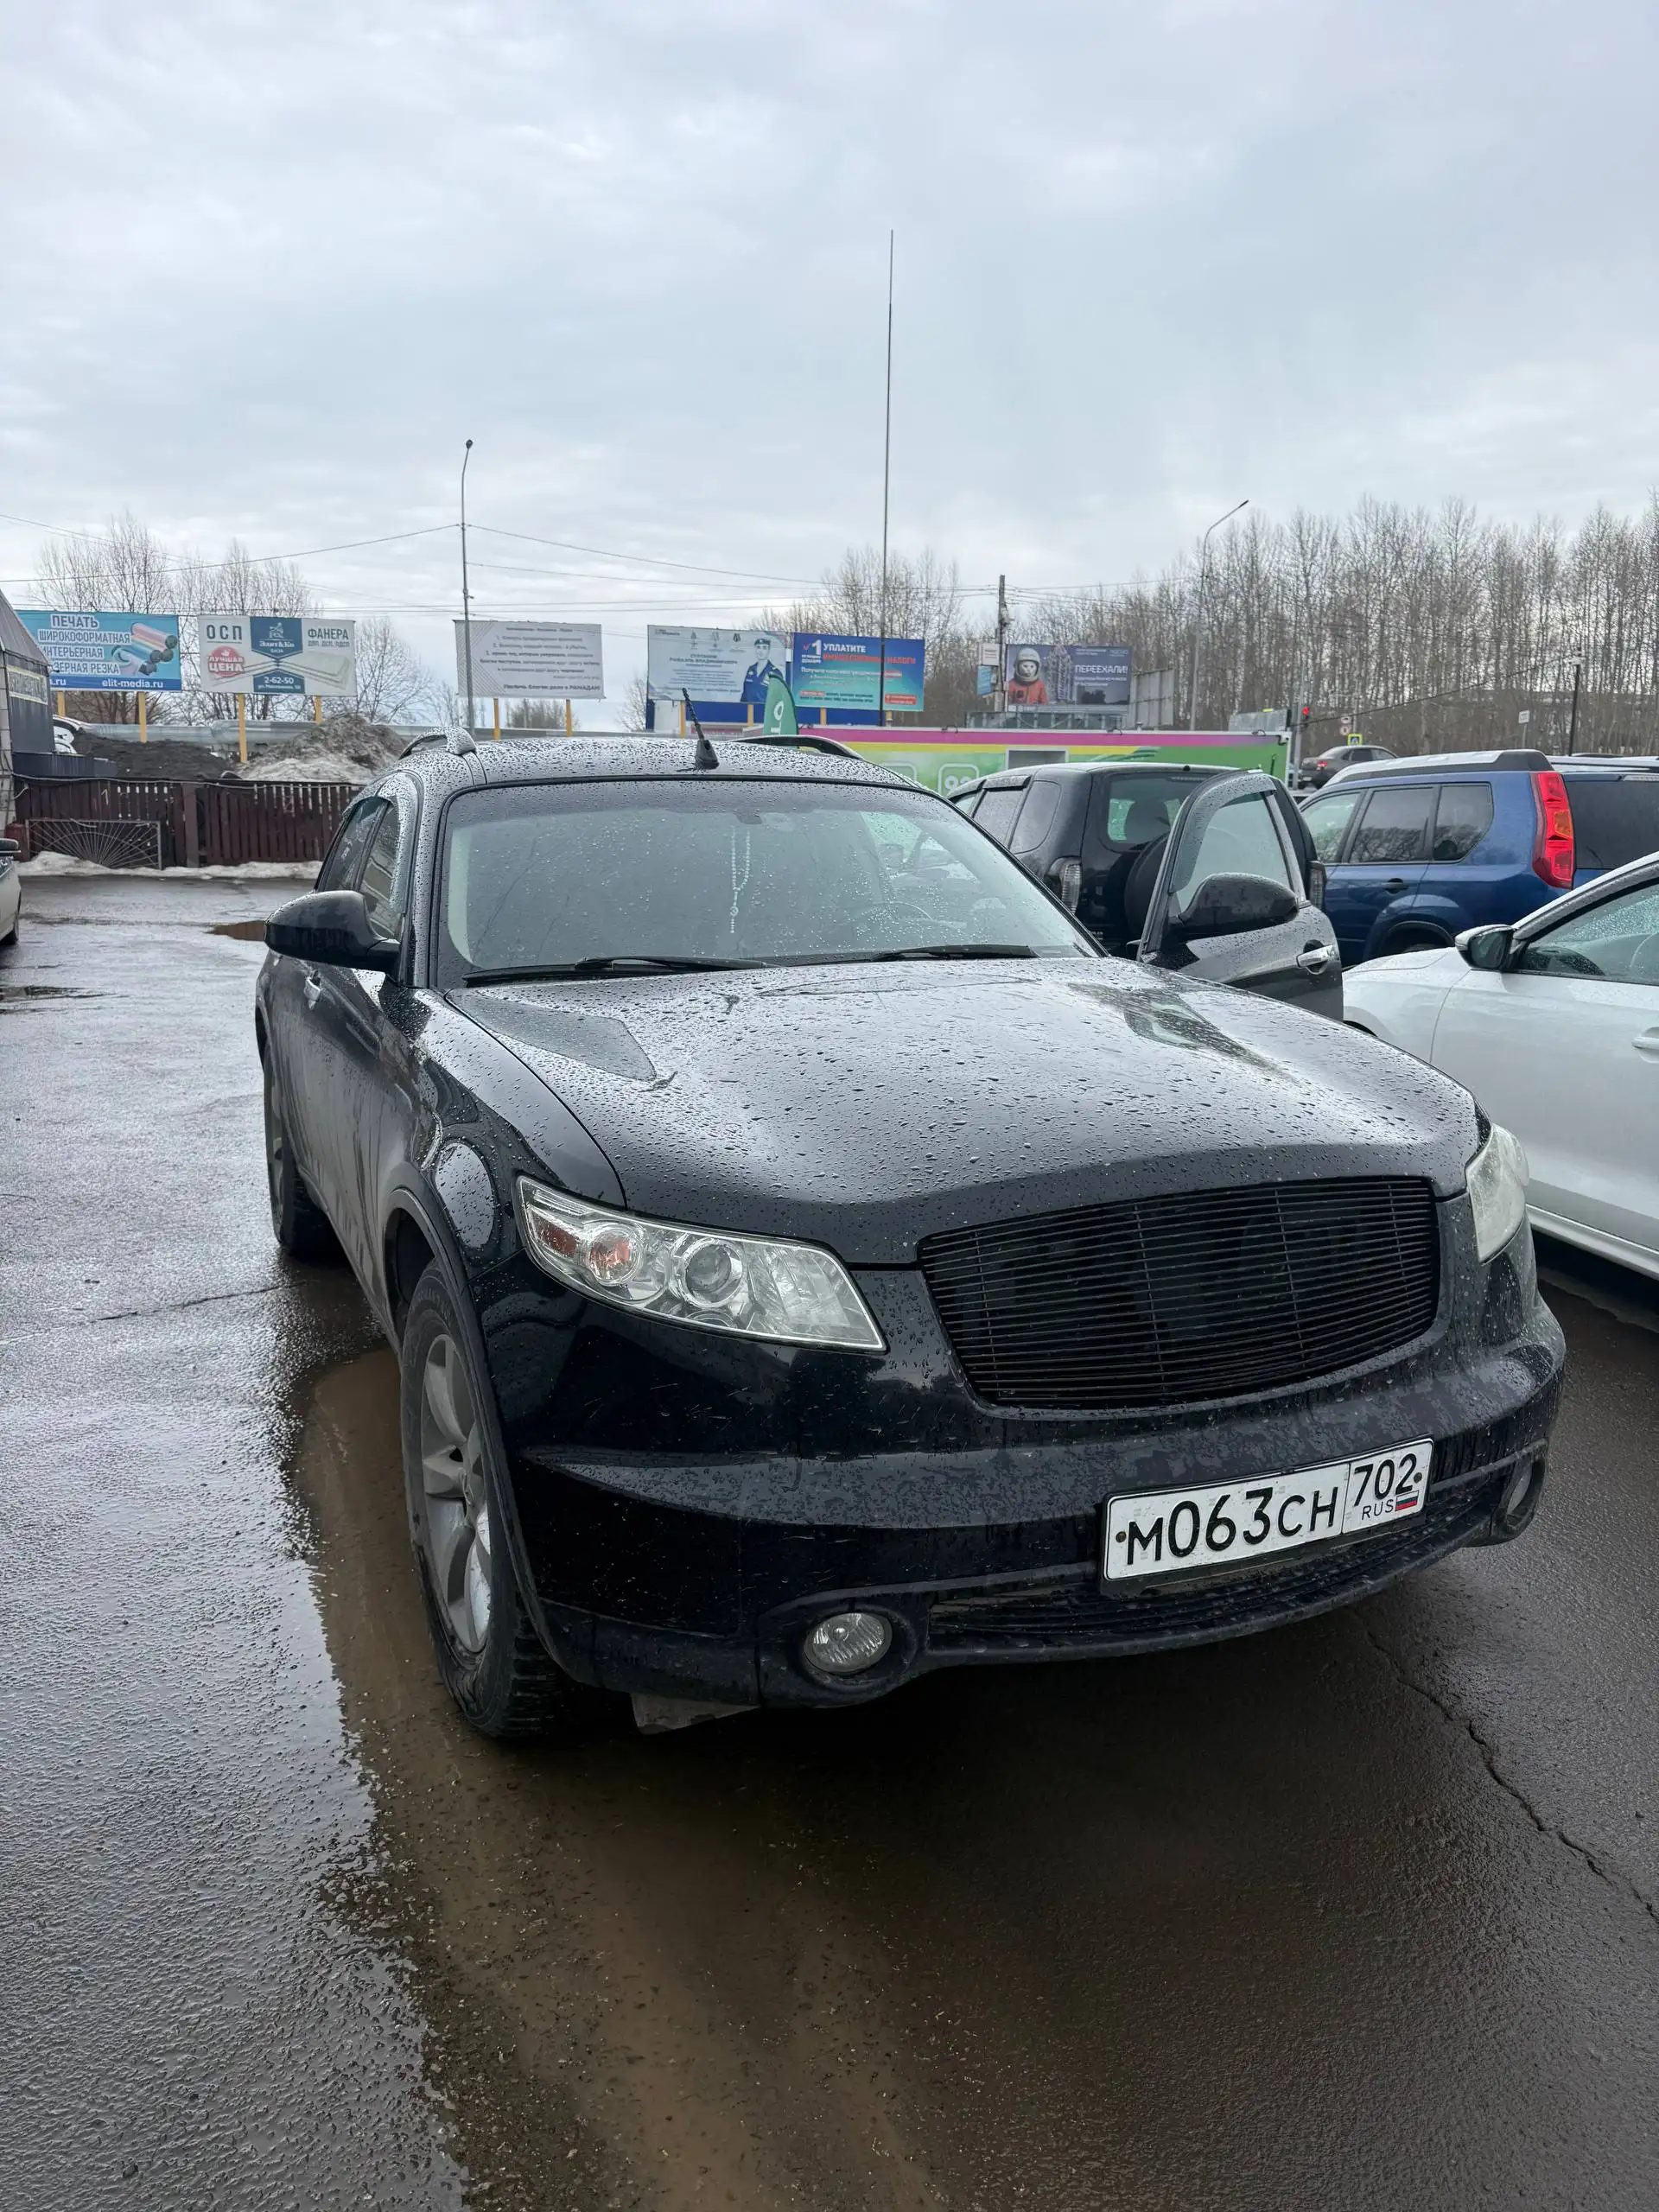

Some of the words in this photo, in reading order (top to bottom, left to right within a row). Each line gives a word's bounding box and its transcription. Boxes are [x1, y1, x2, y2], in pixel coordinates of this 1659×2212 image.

[53, 615, 98, 628] ПЕЧАТЬ
[39, 631, 130, 643] ШИРОКОФОРМАТНАЯ
[207, 625, 243, 640] ОСП
[308, 627, 349, 640] ФАНЕРА
[823, 643, 867, 653] УПЛАТИТЕ
[53, 662, 88, 673] ЗЕРНАЯ
[91, 663, 119, 674] РЕЗКА
[209, 662, 244, 672] ЦЕНА
[102, 678, 164, 689] elit-media.ru
[1354, 1453, 1417, 1506] 702
[1362, 1498, 1395, 1521] RUS
